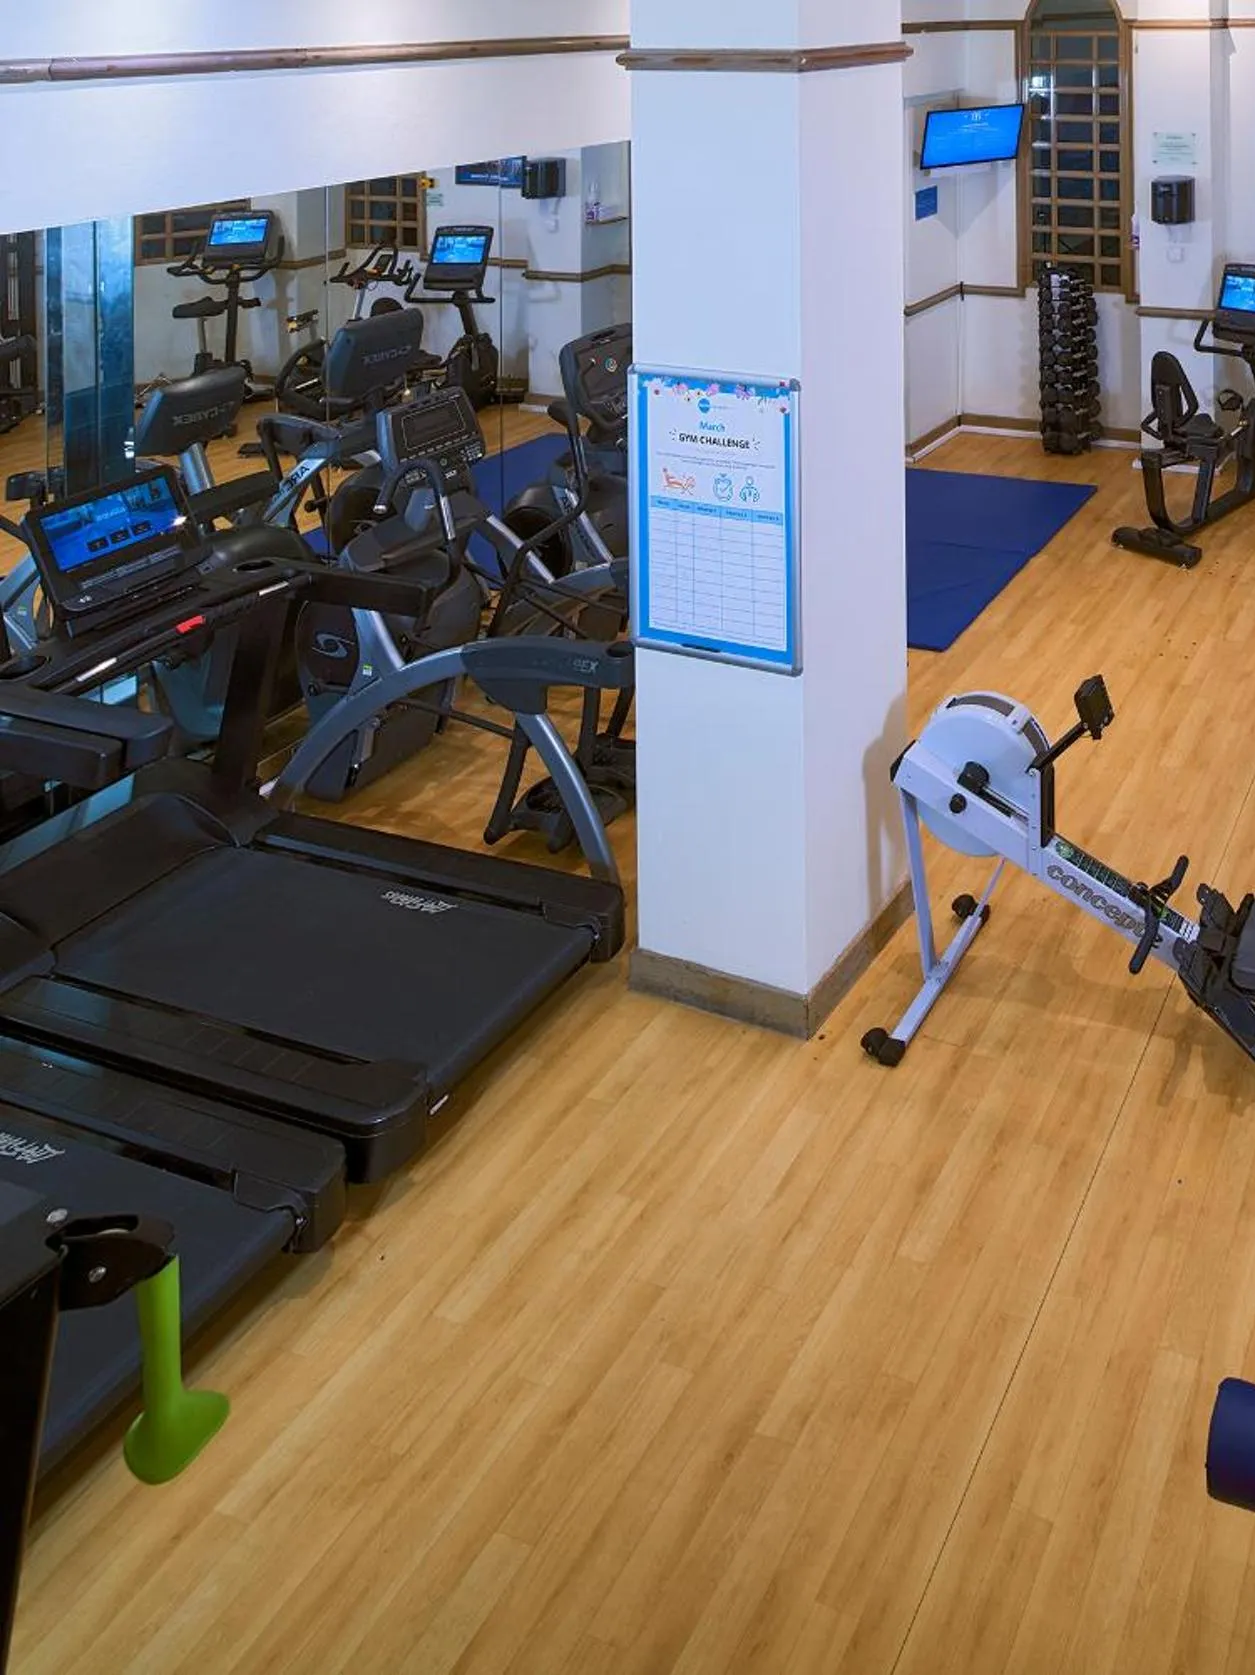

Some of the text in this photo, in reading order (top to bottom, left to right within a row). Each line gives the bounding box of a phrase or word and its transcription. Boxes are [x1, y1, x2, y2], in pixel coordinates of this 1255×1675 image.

[700, 421, 726, 433] March
[678, 432, 751, 450] GYM CHALLENGE
